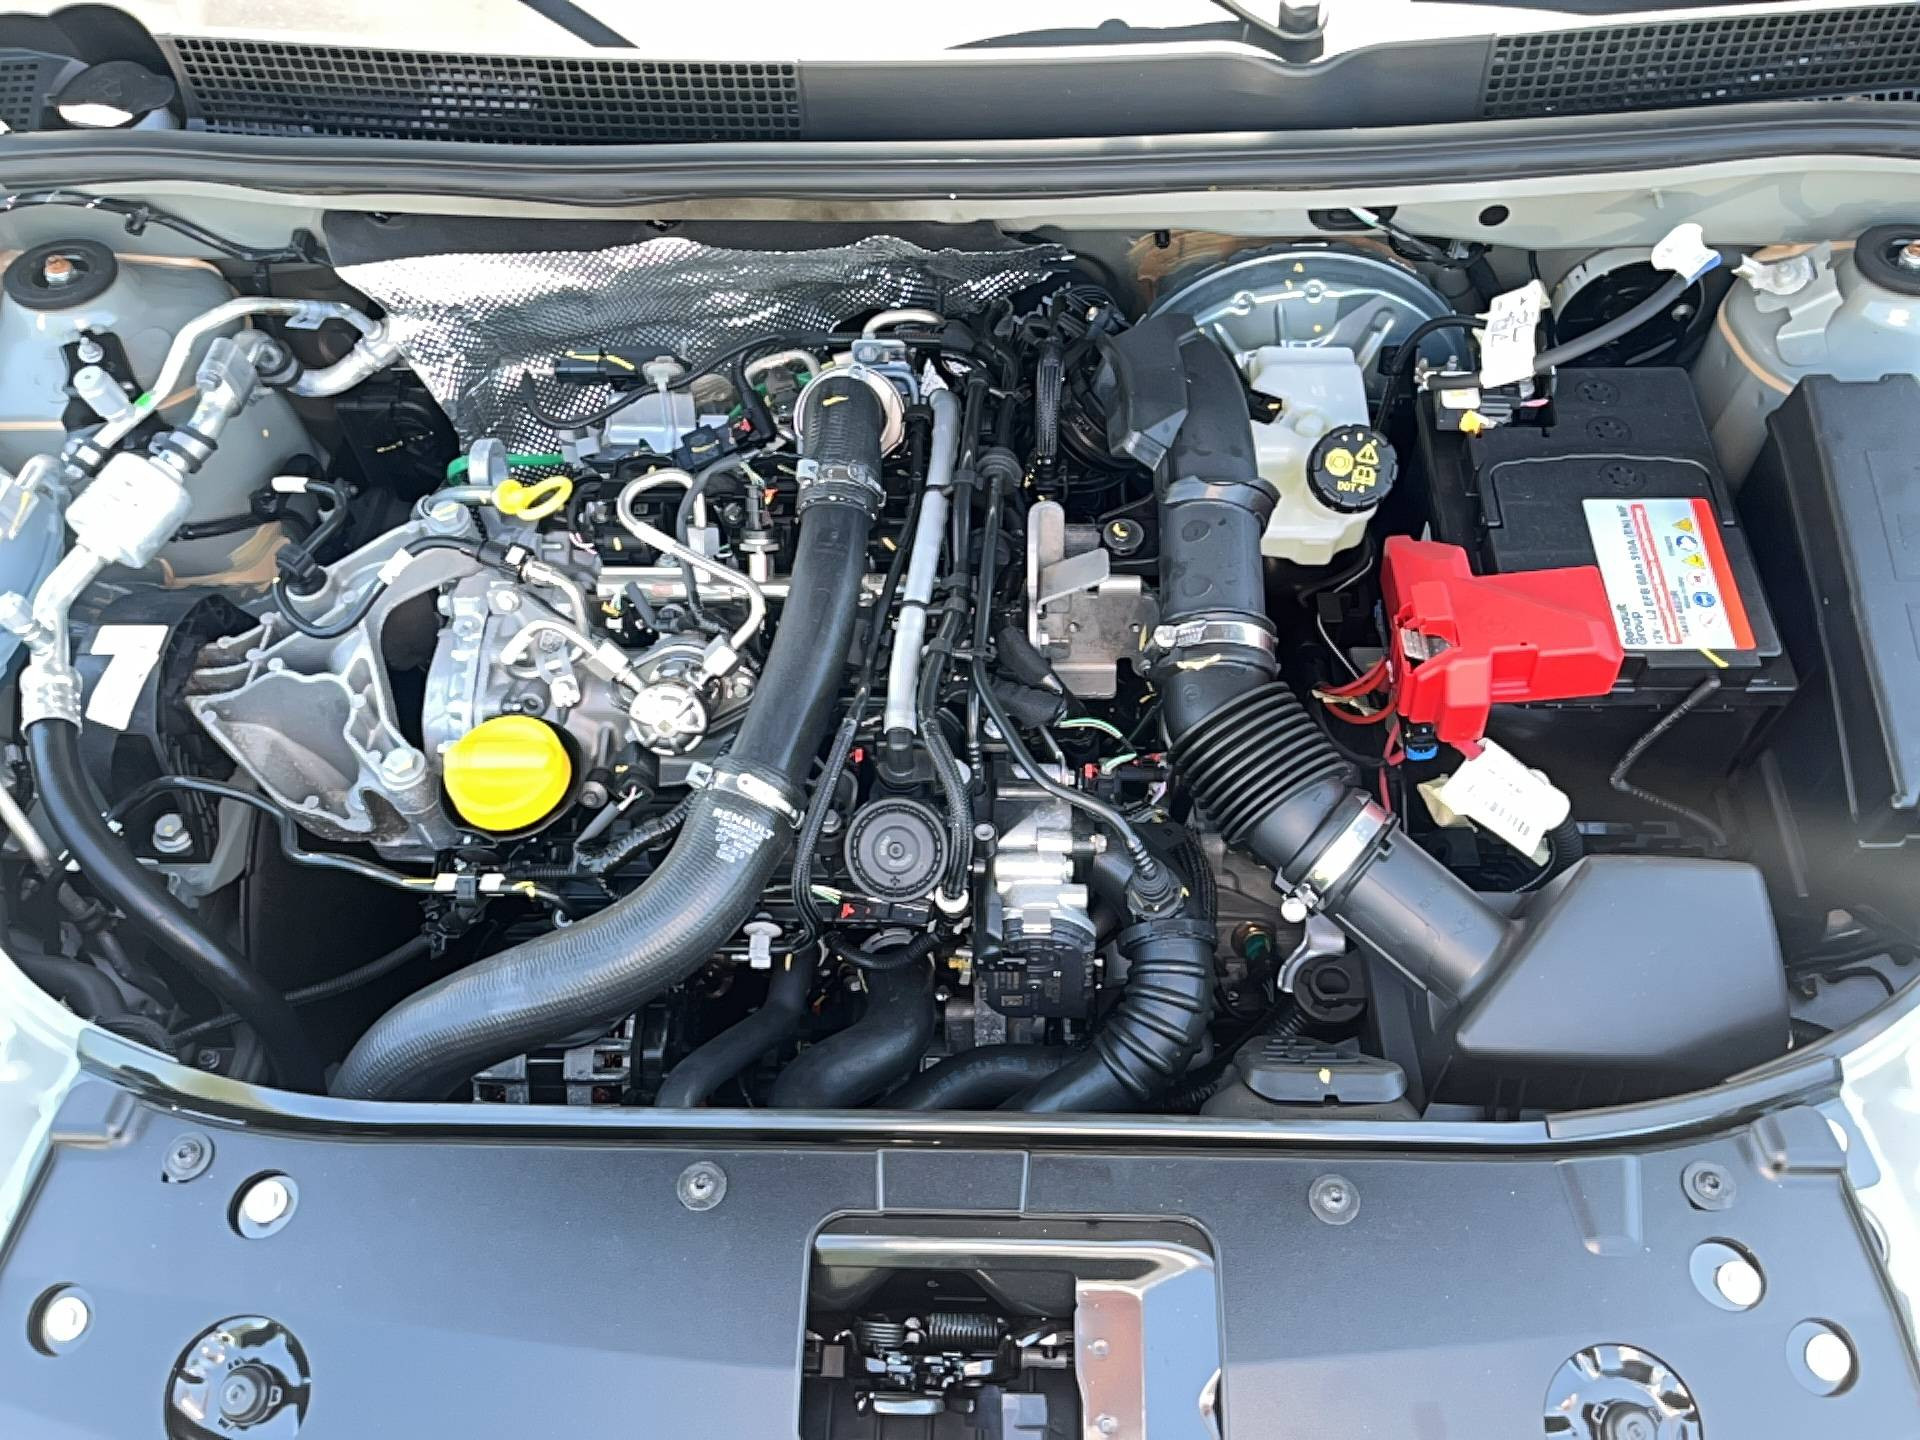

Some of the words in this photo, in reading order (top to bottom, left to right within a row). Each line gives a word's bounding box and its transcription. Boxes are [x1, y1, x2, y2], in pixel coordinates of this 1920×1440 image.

[1337, 481, 1357, 492] DOT
[1616, 604, 1635, 645] Renault
[1631, 612, 1648, 645] Group
[711, 807, 775, 840] RENAULT
